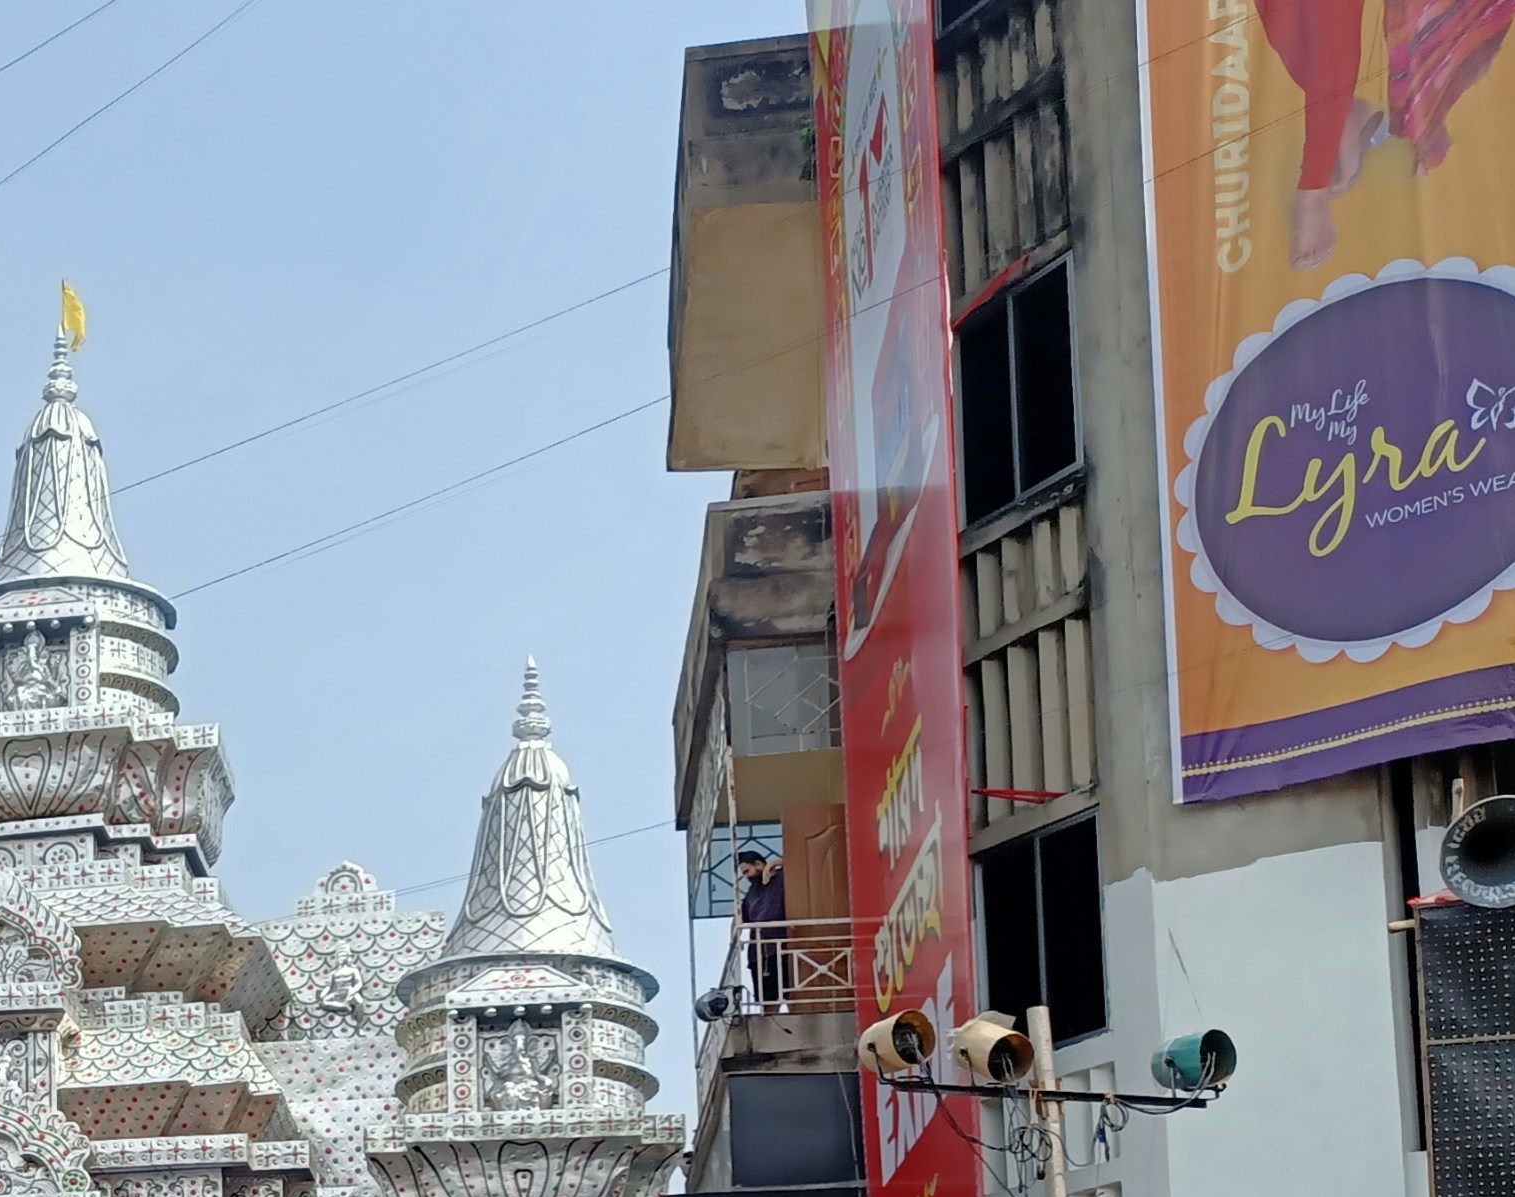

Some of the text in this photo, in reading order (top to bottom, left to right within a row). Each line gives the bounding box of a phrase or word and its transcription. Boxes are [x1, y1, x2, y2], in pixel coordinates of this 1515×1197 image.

[1290, 379, 1370, 432] My Life
[1327, 420, 1358, 446] My
[1225, 414, 1486, 558] Lyra
[1365, 471, 1515, 529] WOMEN'S WEA
